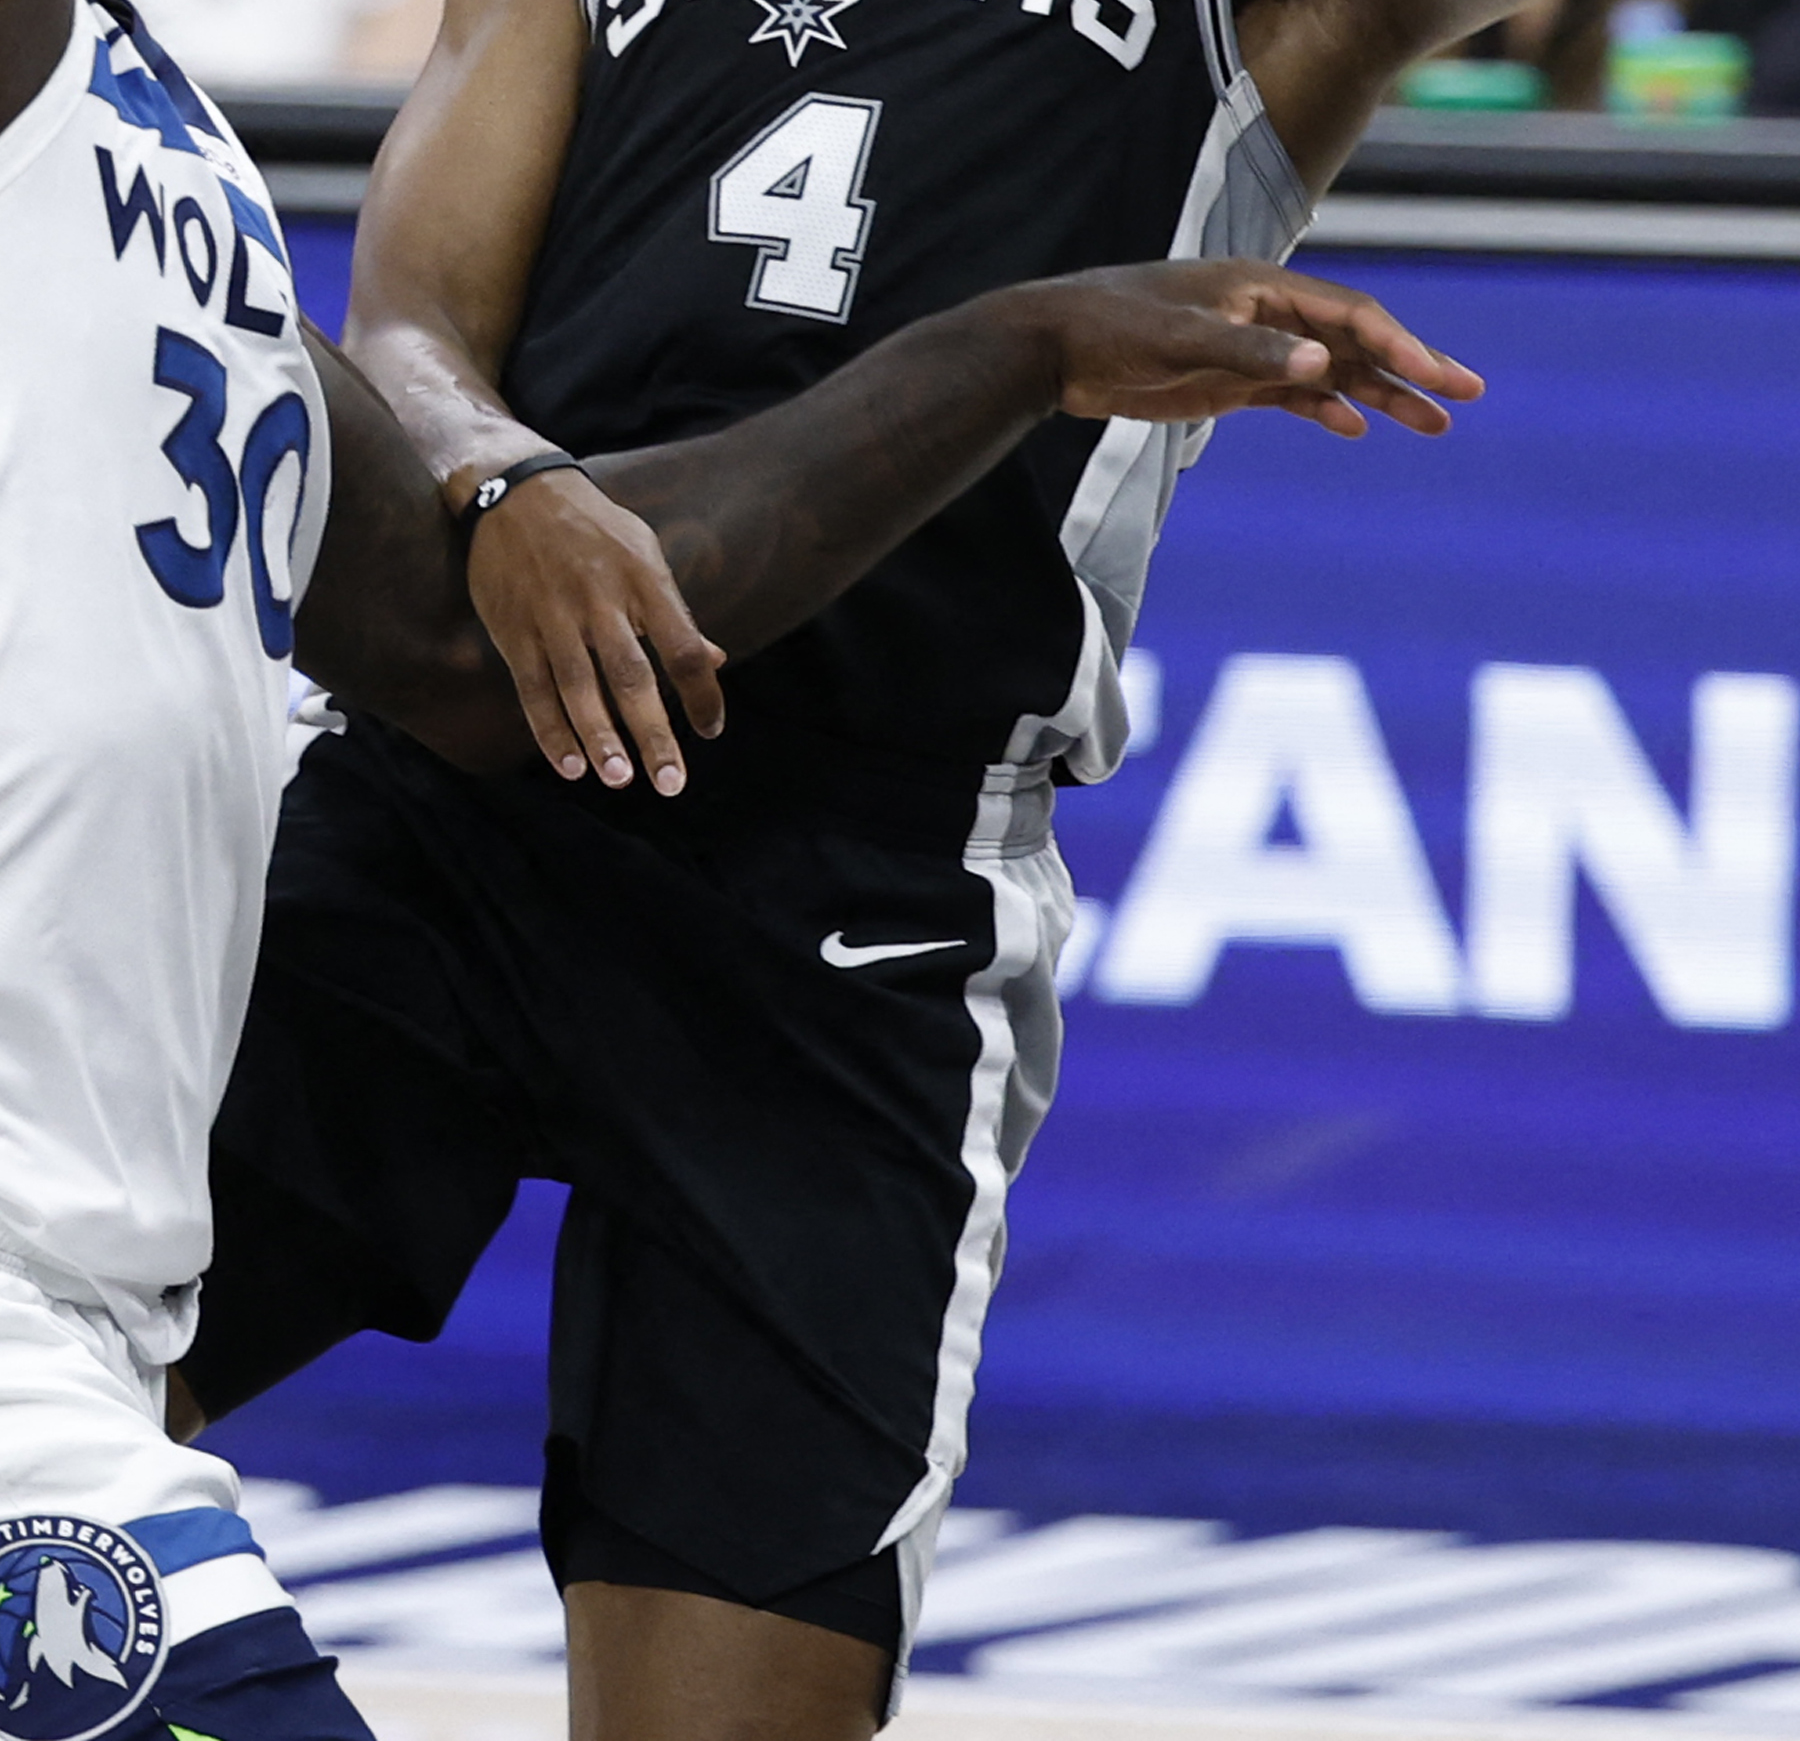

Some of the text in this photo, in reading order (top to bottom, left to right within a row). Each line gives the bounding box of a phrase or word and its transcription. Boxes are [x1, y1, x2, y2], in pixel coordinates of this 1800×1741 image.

[94, 146, 292, 339] WOL
[708, 91, 884, 324] 4
[134, 325, 310, 661] 30
